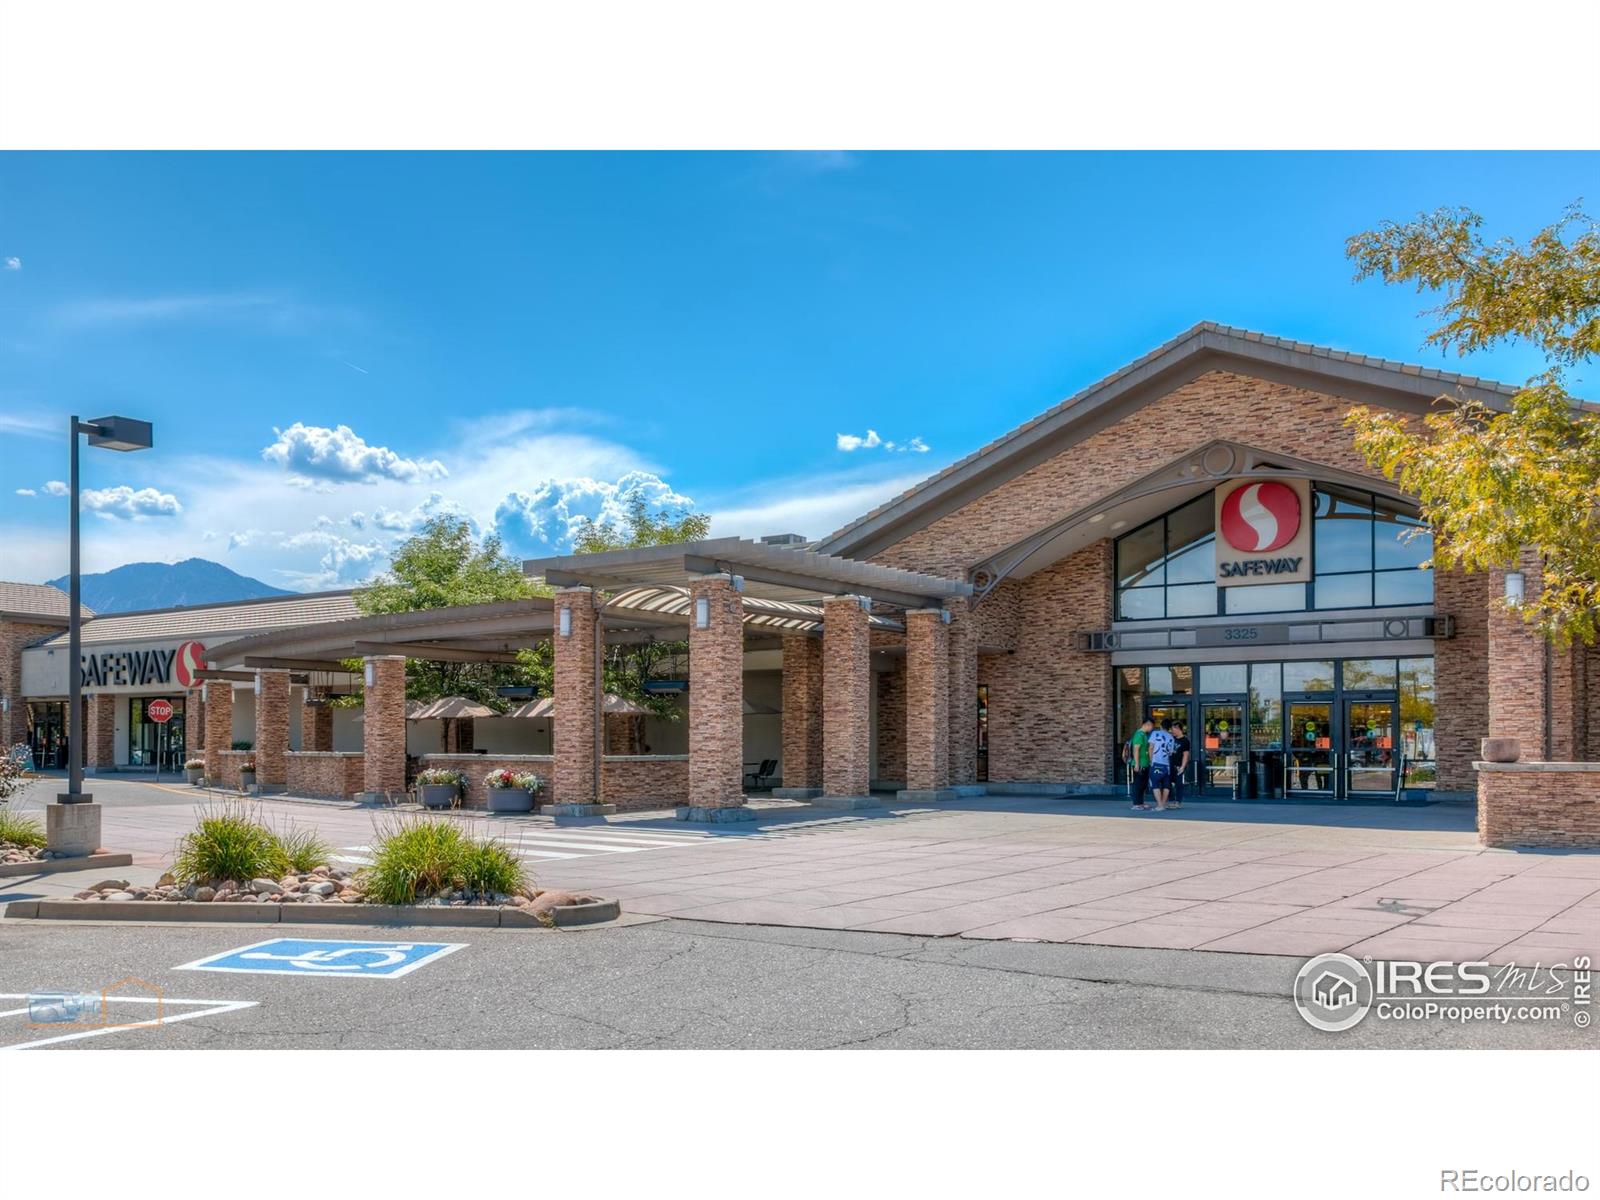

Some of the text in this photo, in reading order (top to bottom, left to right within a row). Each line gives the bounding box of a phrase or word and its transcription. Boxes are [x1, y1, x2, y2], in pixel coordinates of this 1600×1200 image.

[1219, 557, 1303, 578] SAFEWAY
[1224, 627, 1258, 641] 3325
[150, 706, 172, 716] STOP
